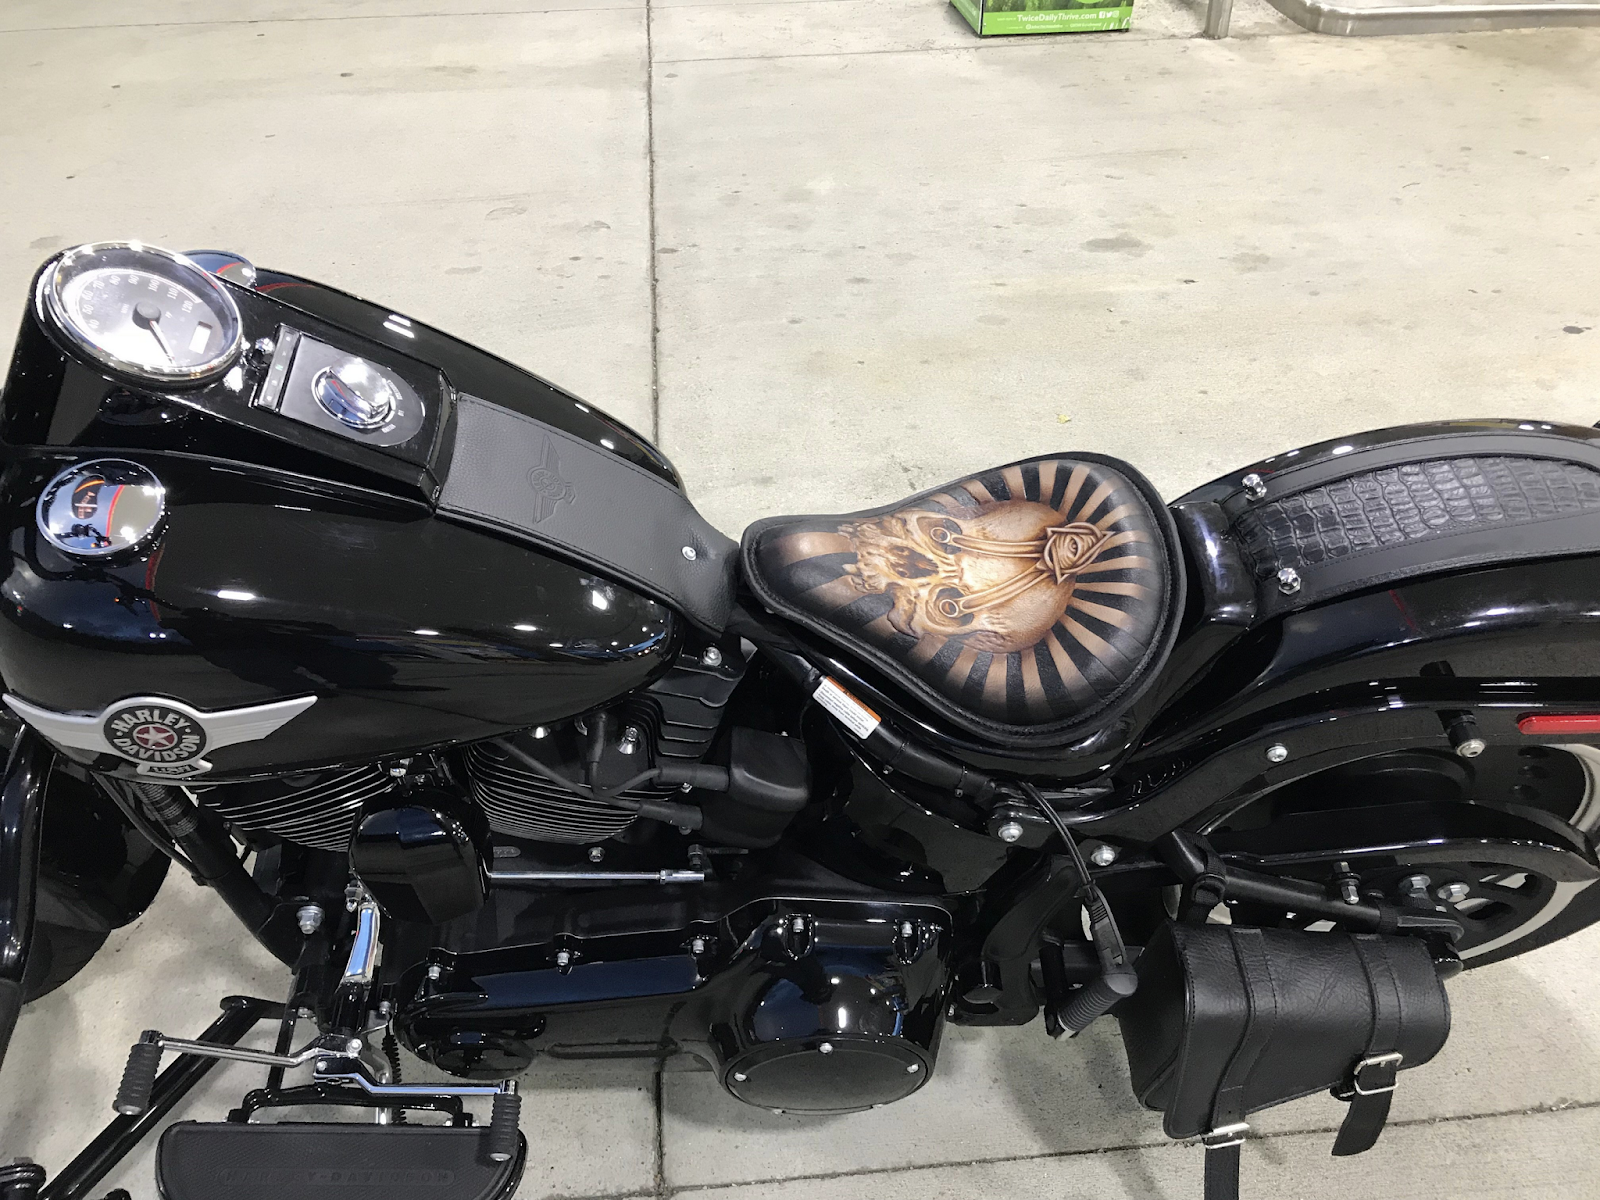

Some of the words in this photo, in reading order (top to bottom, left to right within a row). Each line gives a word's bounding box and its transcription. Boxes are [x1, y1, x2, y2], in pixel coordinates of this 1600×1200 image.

[1017, 12, 1097, 23] TwiceDailyThrive.com
[182, 301, 194, 314] 120
[111, 709, 191, 733] HARLEY
[113, 735, 200, 761] DAVIDSON
[223, 1170, 449, 1184] HAREY-DAVIDSON
